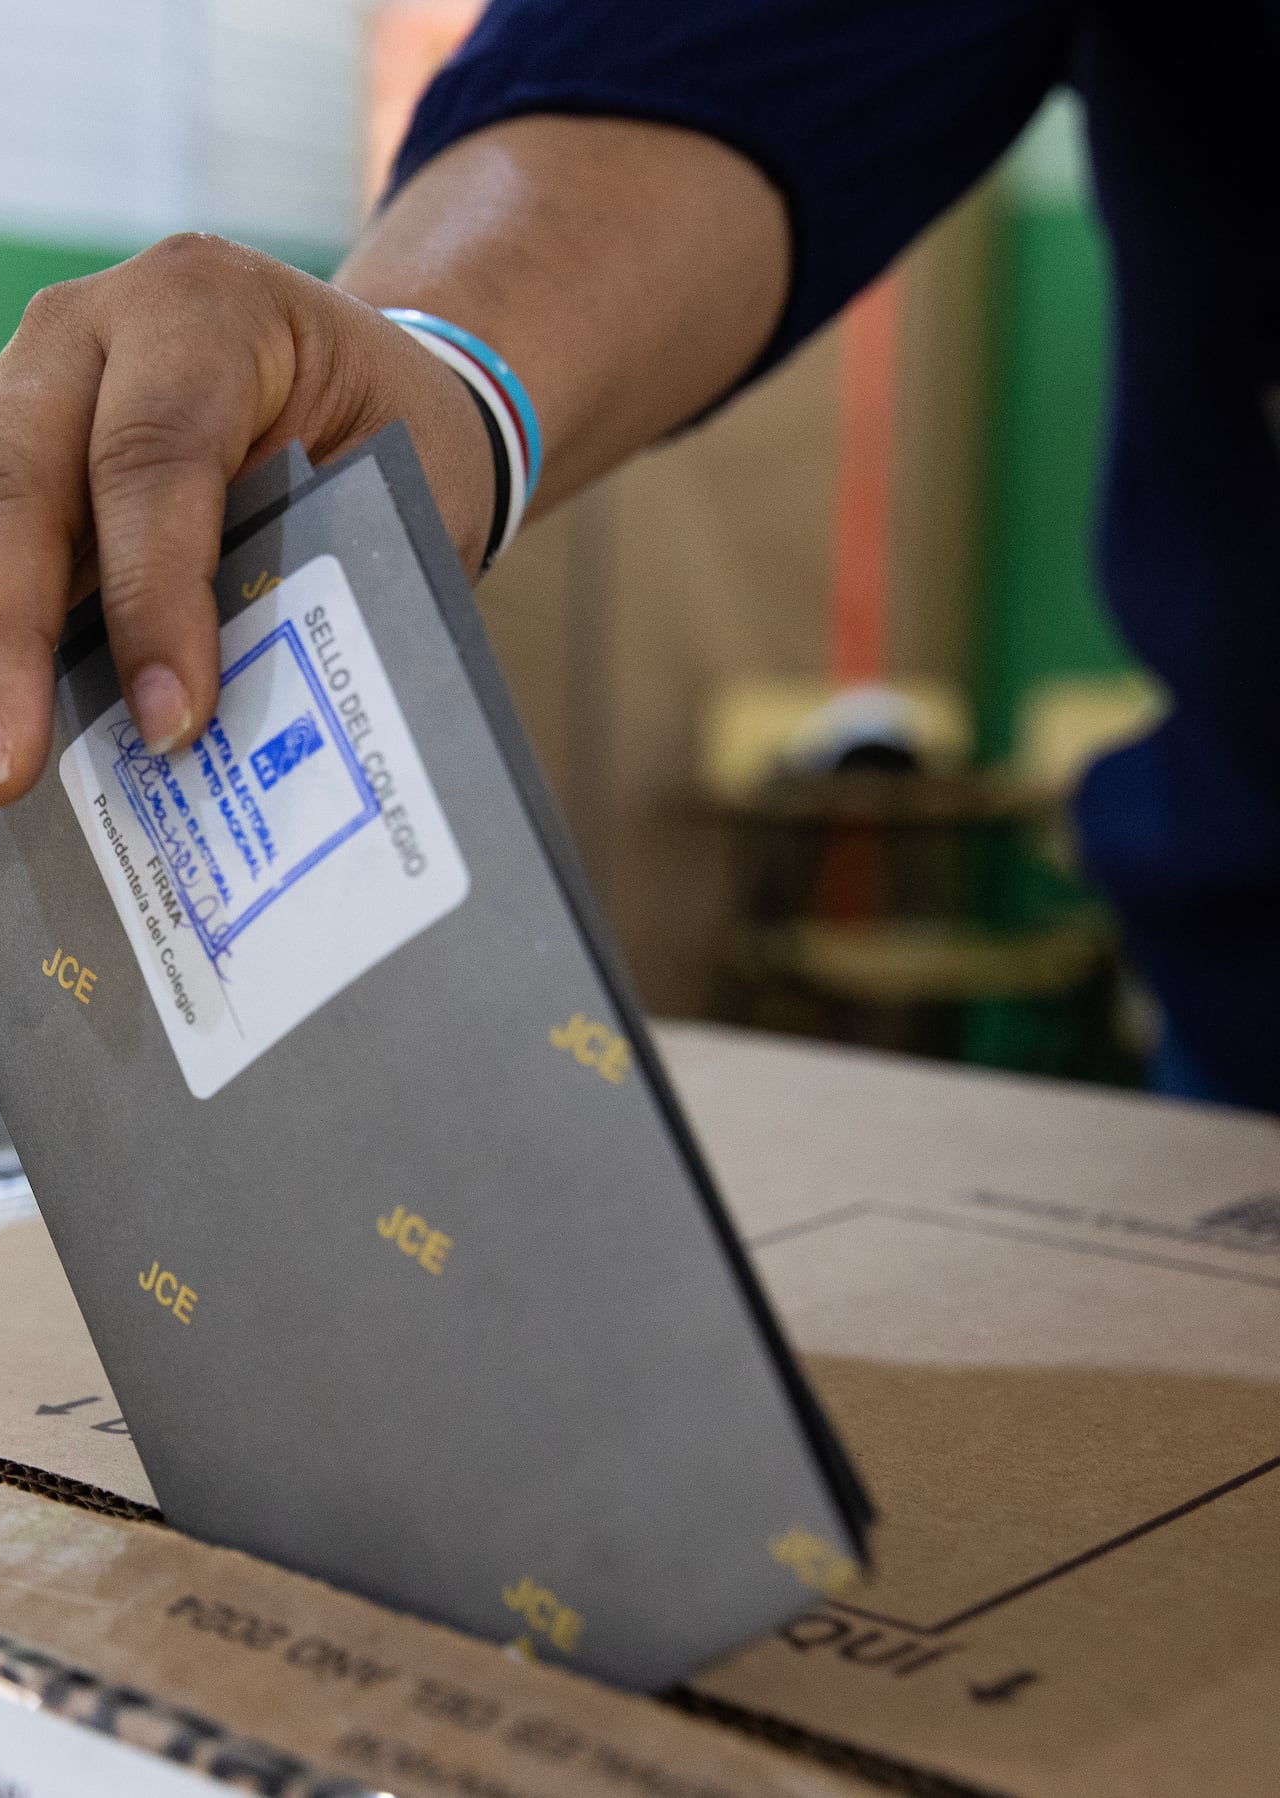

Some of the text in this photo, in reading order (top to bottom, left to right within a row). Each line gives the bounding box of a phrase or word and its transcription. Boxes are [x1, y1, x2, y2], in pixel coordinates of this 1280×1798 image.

[304, 605, 427, 878] SELLO DEL COLEGIO
[207, 716, 277, 866] UNTA ELECTORAL
[146, 855, 186, 930] FIRMA
[186, 817, 234, 908] ELECTORAL
[93, 792, 197, 1026] Presidente/a del Colegio
[42, 948, 98, 1004] JCE
[550, 1012, 629, 1084] JCE
[376, 1205, 454, 1276] JCE
[138, 1261, 198, 1324] JCE
